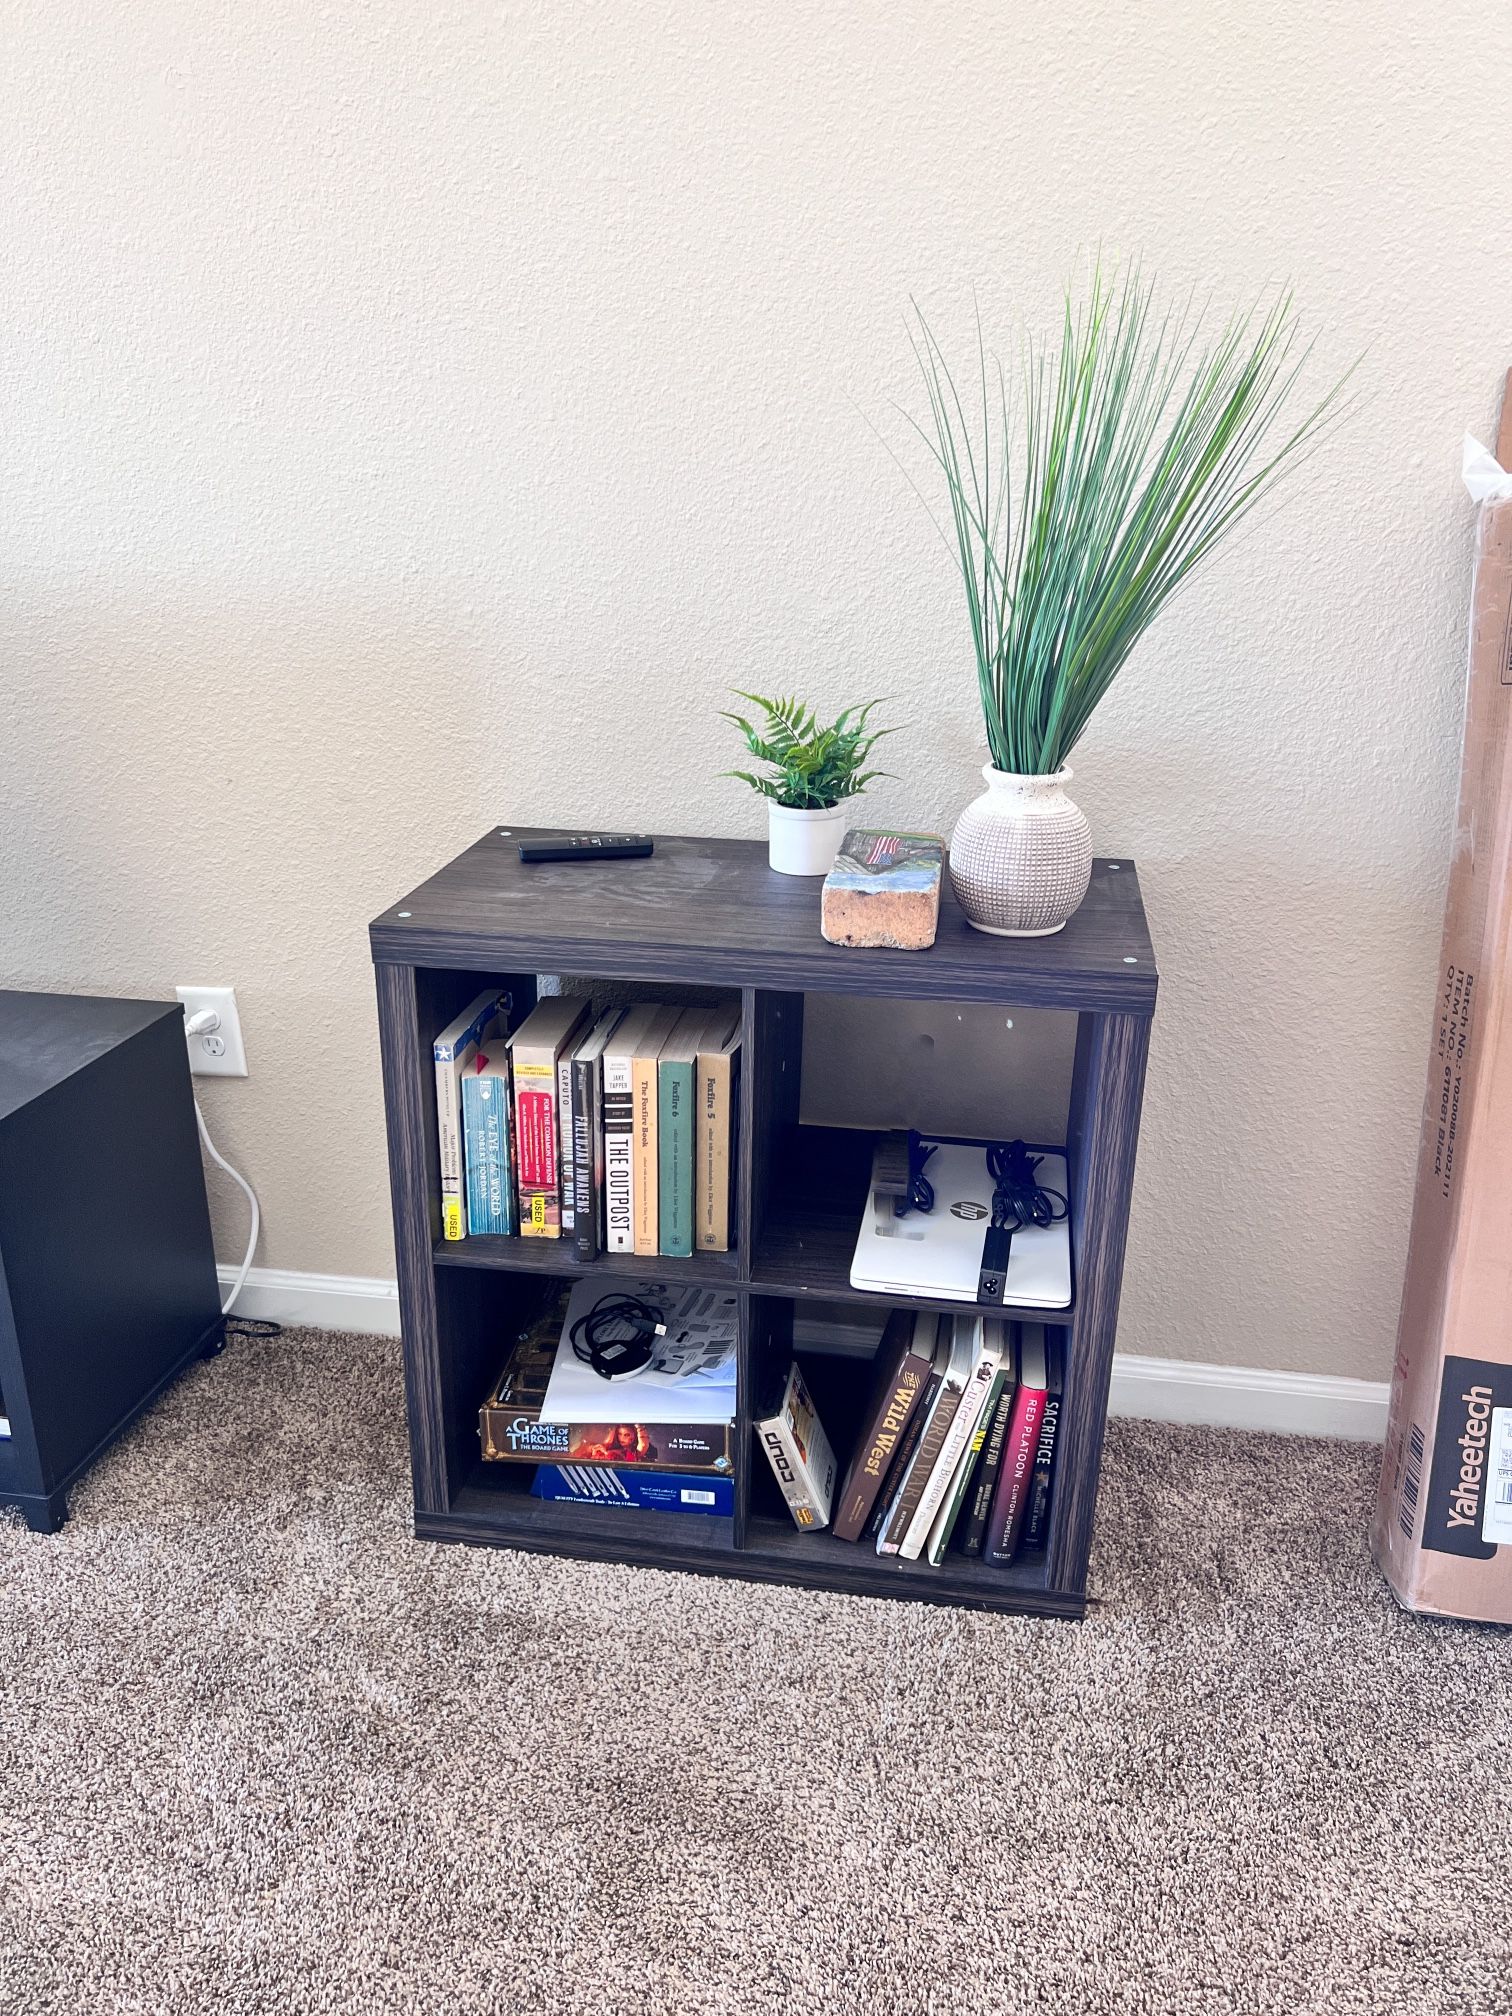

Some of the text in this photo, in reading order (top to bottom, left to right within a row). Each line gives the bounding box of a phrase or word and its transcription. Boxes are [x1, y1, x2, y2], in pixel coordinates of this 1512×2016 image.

[1443, 966, 1454, 1008] QTY:
[1452, 970, 1464, 1015] ITEM
[1461, 974, 1473, 1027] Batch
[1438, 1026, 1446, 1060] SET
[1456, 1033, 1466, 1070] No.:
[708, 1078, 716, 1109] Foxfire
[488, 1114, 498, 1129] The
[489, 1132, 498, 1152] EYE
[478, 1130, 488, 1199] ROBERT JORDAN
[575, 1116, 590, 1214] FALLUJAH AWAKENS
[610, 1139, 628, 1164] THE
[1435, 1128, 1446, 1176] Black
[490, 1178, 500, 1216] WORLD
[534, 1200, 542, 1222] USED
[610, 1170, 630, 1231] OUTPOST
[450, 1214, 458, 1238] USED
[959, 1380, 986, 1424] Custer
[506, 1432, 568, 1450] THRONES
[512, 1418, 556, 1436] GAME
[864, 1372, 916, 1476] THE Wild West
[920, 1398, 958, 1458] WORLD
[972, 1430, 986, 1453] NAM
[986, 1394, 1012, 1466] WORTH DYING FOR
[1014, 1399, 1038, 1478] RED PLATOON
[1036, 1400, 1059, 1465] SACRIFICE
[926, 1434, 966, 1510] LITTLE BIGHORN
[1446, 1386, 1492, 1528] Yaheetech
[904, 1464, 930, 1498] WAR
[1033, 1486, 1042, 1514] MICHELLE
[1002, 1484, 1020, 1547] CLINTON ROMESHA
